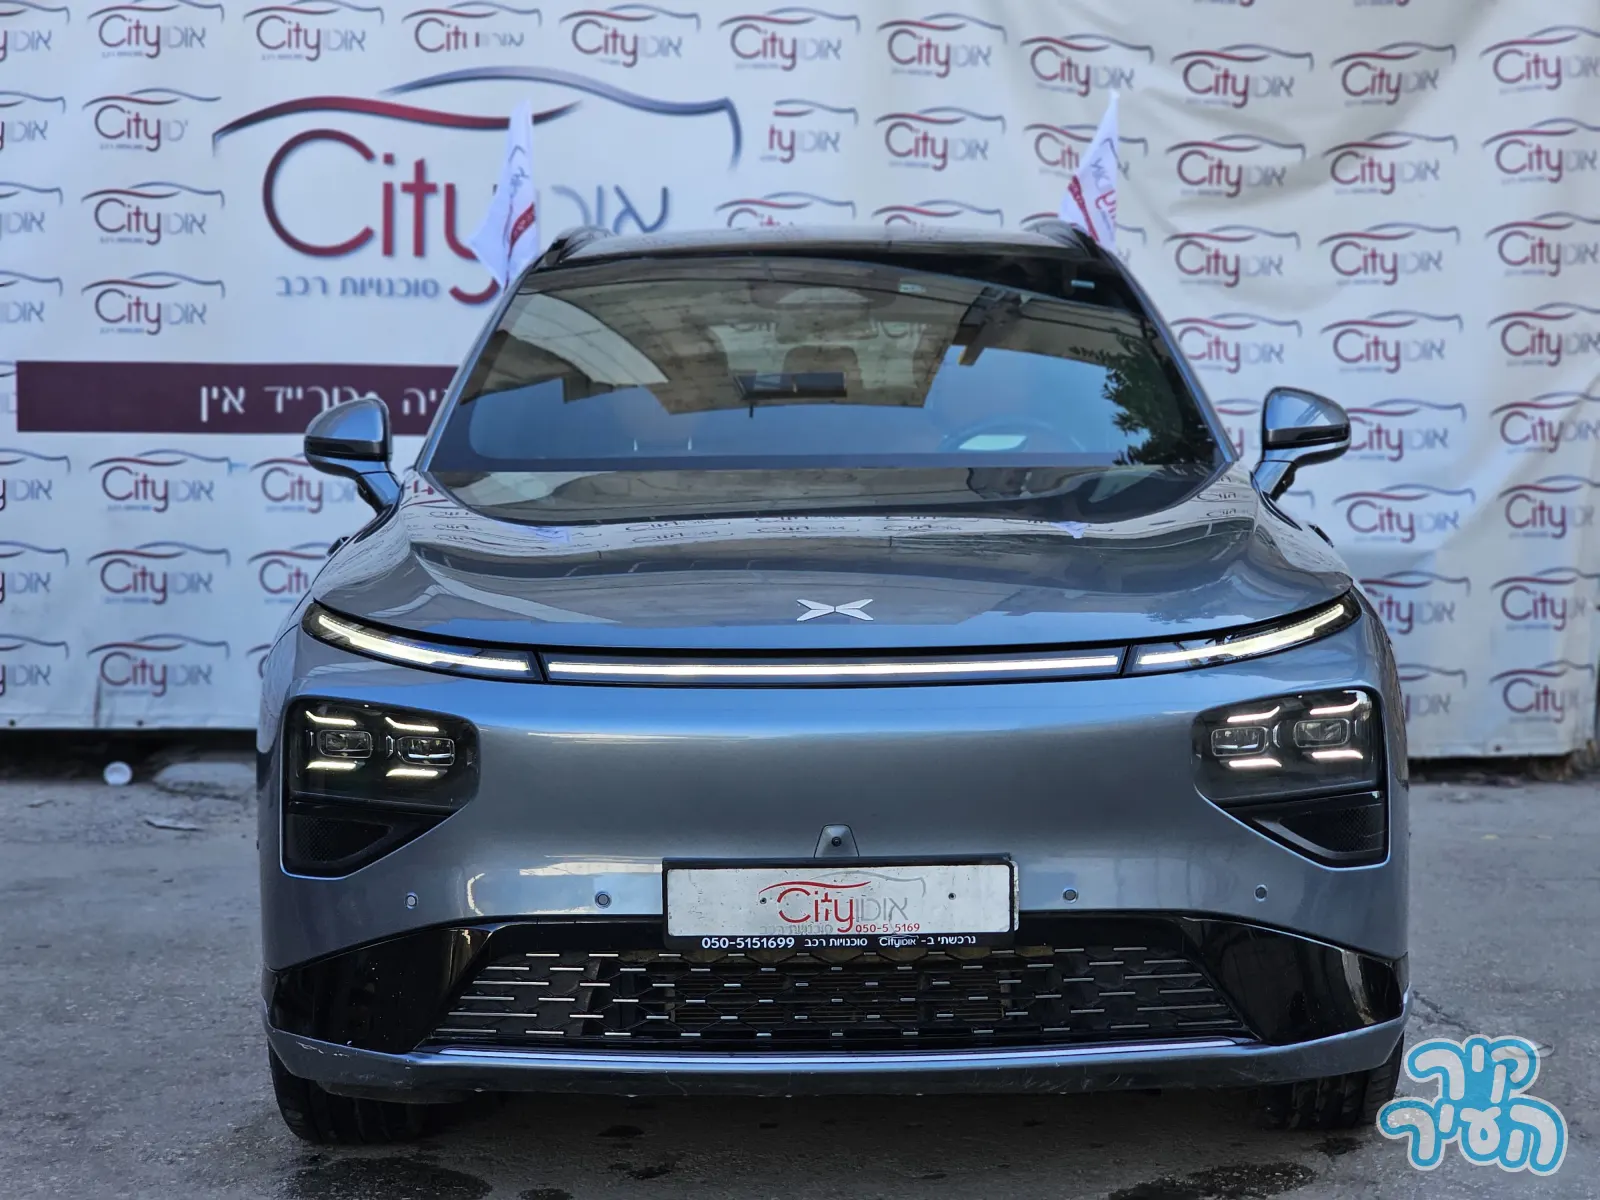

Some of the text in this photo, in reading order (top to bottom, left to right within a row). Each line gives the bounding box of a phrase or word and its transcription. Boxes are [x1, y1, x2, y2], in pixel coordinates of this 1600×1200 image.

[99, 14, 160, 58] City
[256, 15, 320, 61] City
[572, 19, 638, 67] City
[730, 23, 797, 70] City
[888, 29, 950, 78] City
[1030, 45, 1090, 97] City
[1183, 59, 1250, 109] City
[1341, 61, 1401, 105] City
[1492, 49, 1562, 90] City
[95, 105, 160, 151] City
[768, 125, 796, 163] ty
[885, 121, 948, 171] City
[1034, 132, 1079, 170] Cit
[1177, 150, 1243, 197] City
[1330, 150, 1395, 195] City
[1495, 139, 1563, 183] City
[95, 198, 160, 245] City
[1174, 239, 1240, 288] City
[1330, 241, 1398, 286] City
[1498, 230, 1561, 277] City
[276, 276, 439, 298] סוכנויות רכב
[95, 288, 161, 335] City
[1178, 328, 1241, 374] City
[1333, 328, 1400, 374] City
[1501, 320, 1563, 367] City
[201, 386, 246, 423] אין
[1500, 410, 1564, 453] City
[102, 466, 169, 512] City
[261, 467, 323, 513] City
[1347, 500, 1416, 543] City
[1505, 493, 1567, 539] City
[100, 559, 167, 604] City
[259, 559, 308, 594] Cit
[1501, 585, 1566, 631] City
[101, 652, 167, 697] City
[1503, 677, 1565, 722] City
[777, 887, 854, 933] City
[701, 937, 795, 949] 050-5151699
[803, 938, 826, 948] רכב
[829, 937, 868, 947] סוכנויות
[879, 937, 900, 949] City
[938, 935, 976, 945] נרכשתי
